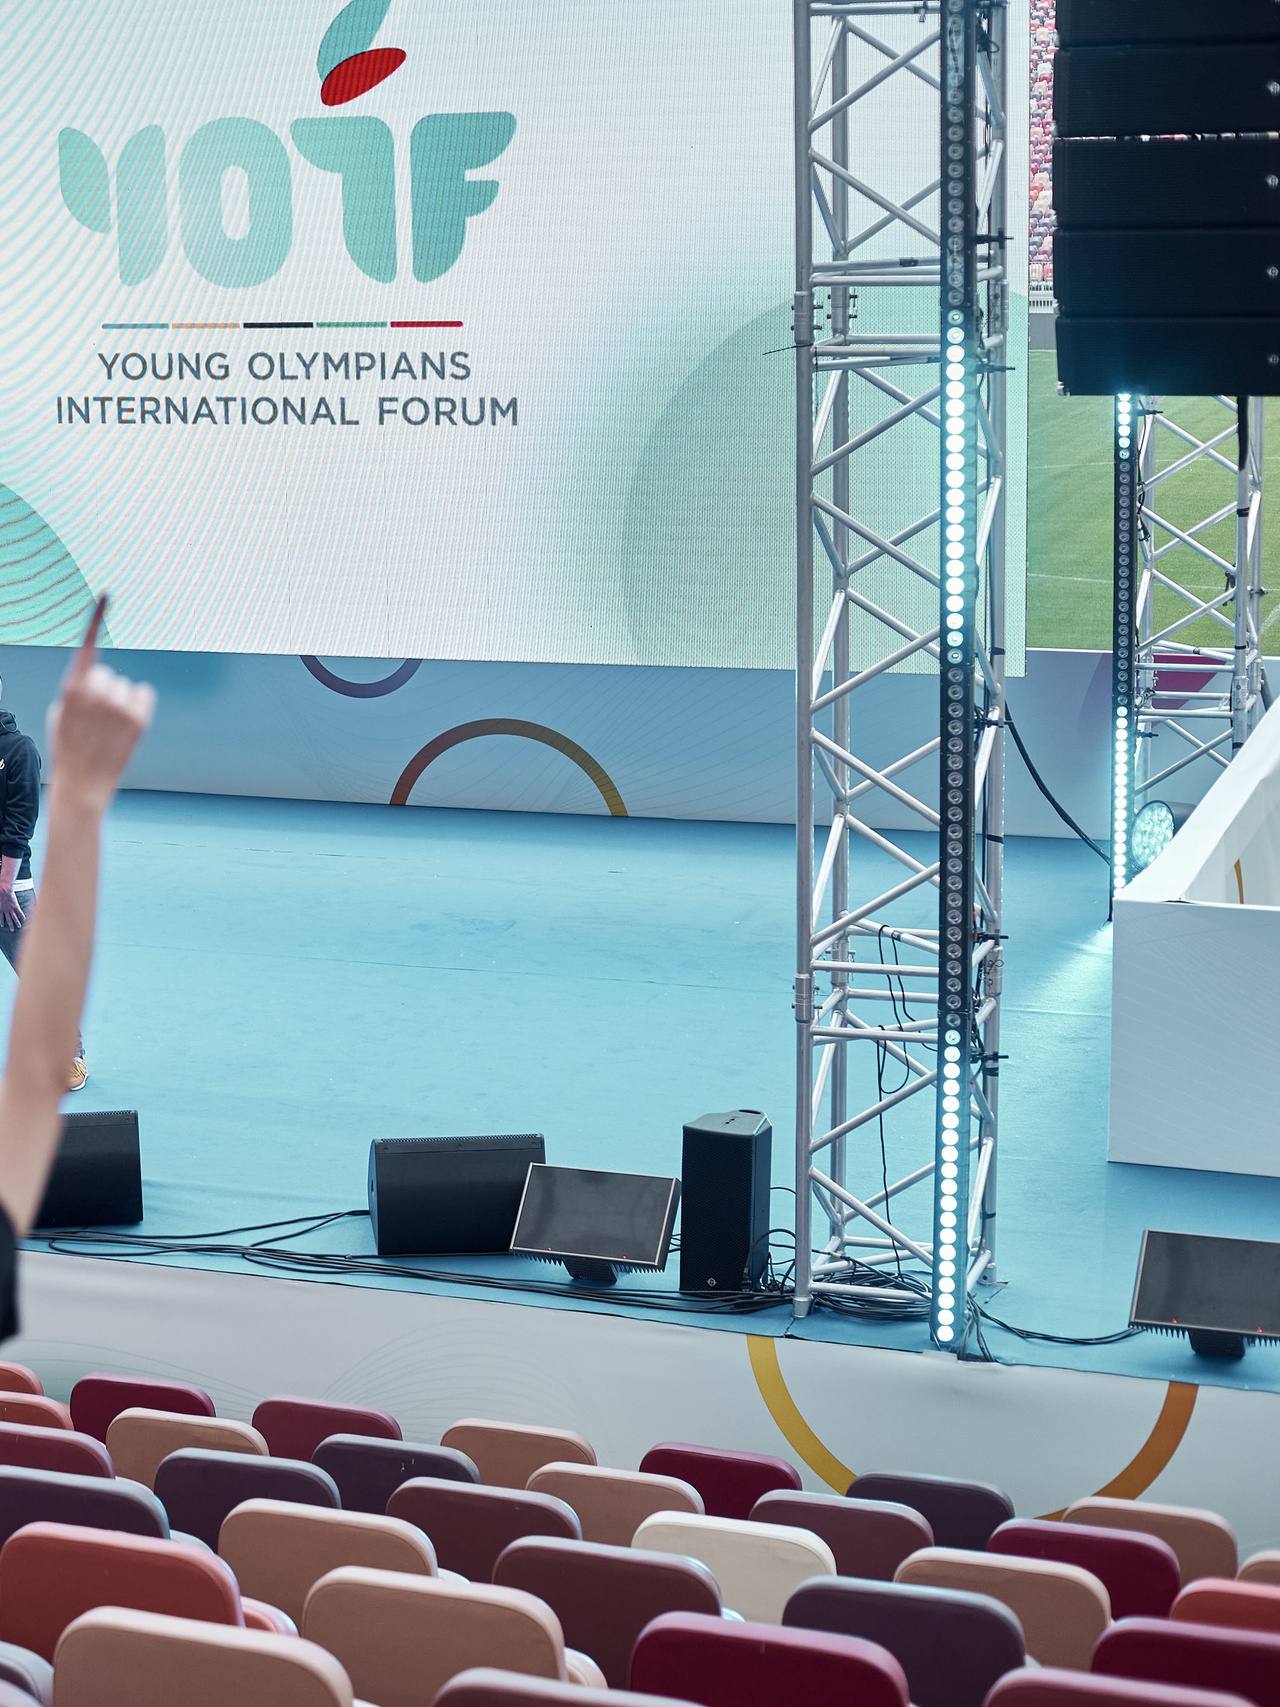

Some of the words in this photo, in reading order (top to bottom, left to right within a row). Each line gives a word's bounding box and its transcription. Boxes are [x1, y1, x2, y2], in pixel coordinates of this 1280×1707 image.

[98, 351, 231, 381] YOUNG
[246, 351, 472, 381] OLYMPIANS
[56, 396, 360, 426] INTERNATIONAL
[377, 396, 519, 426] FORUM
